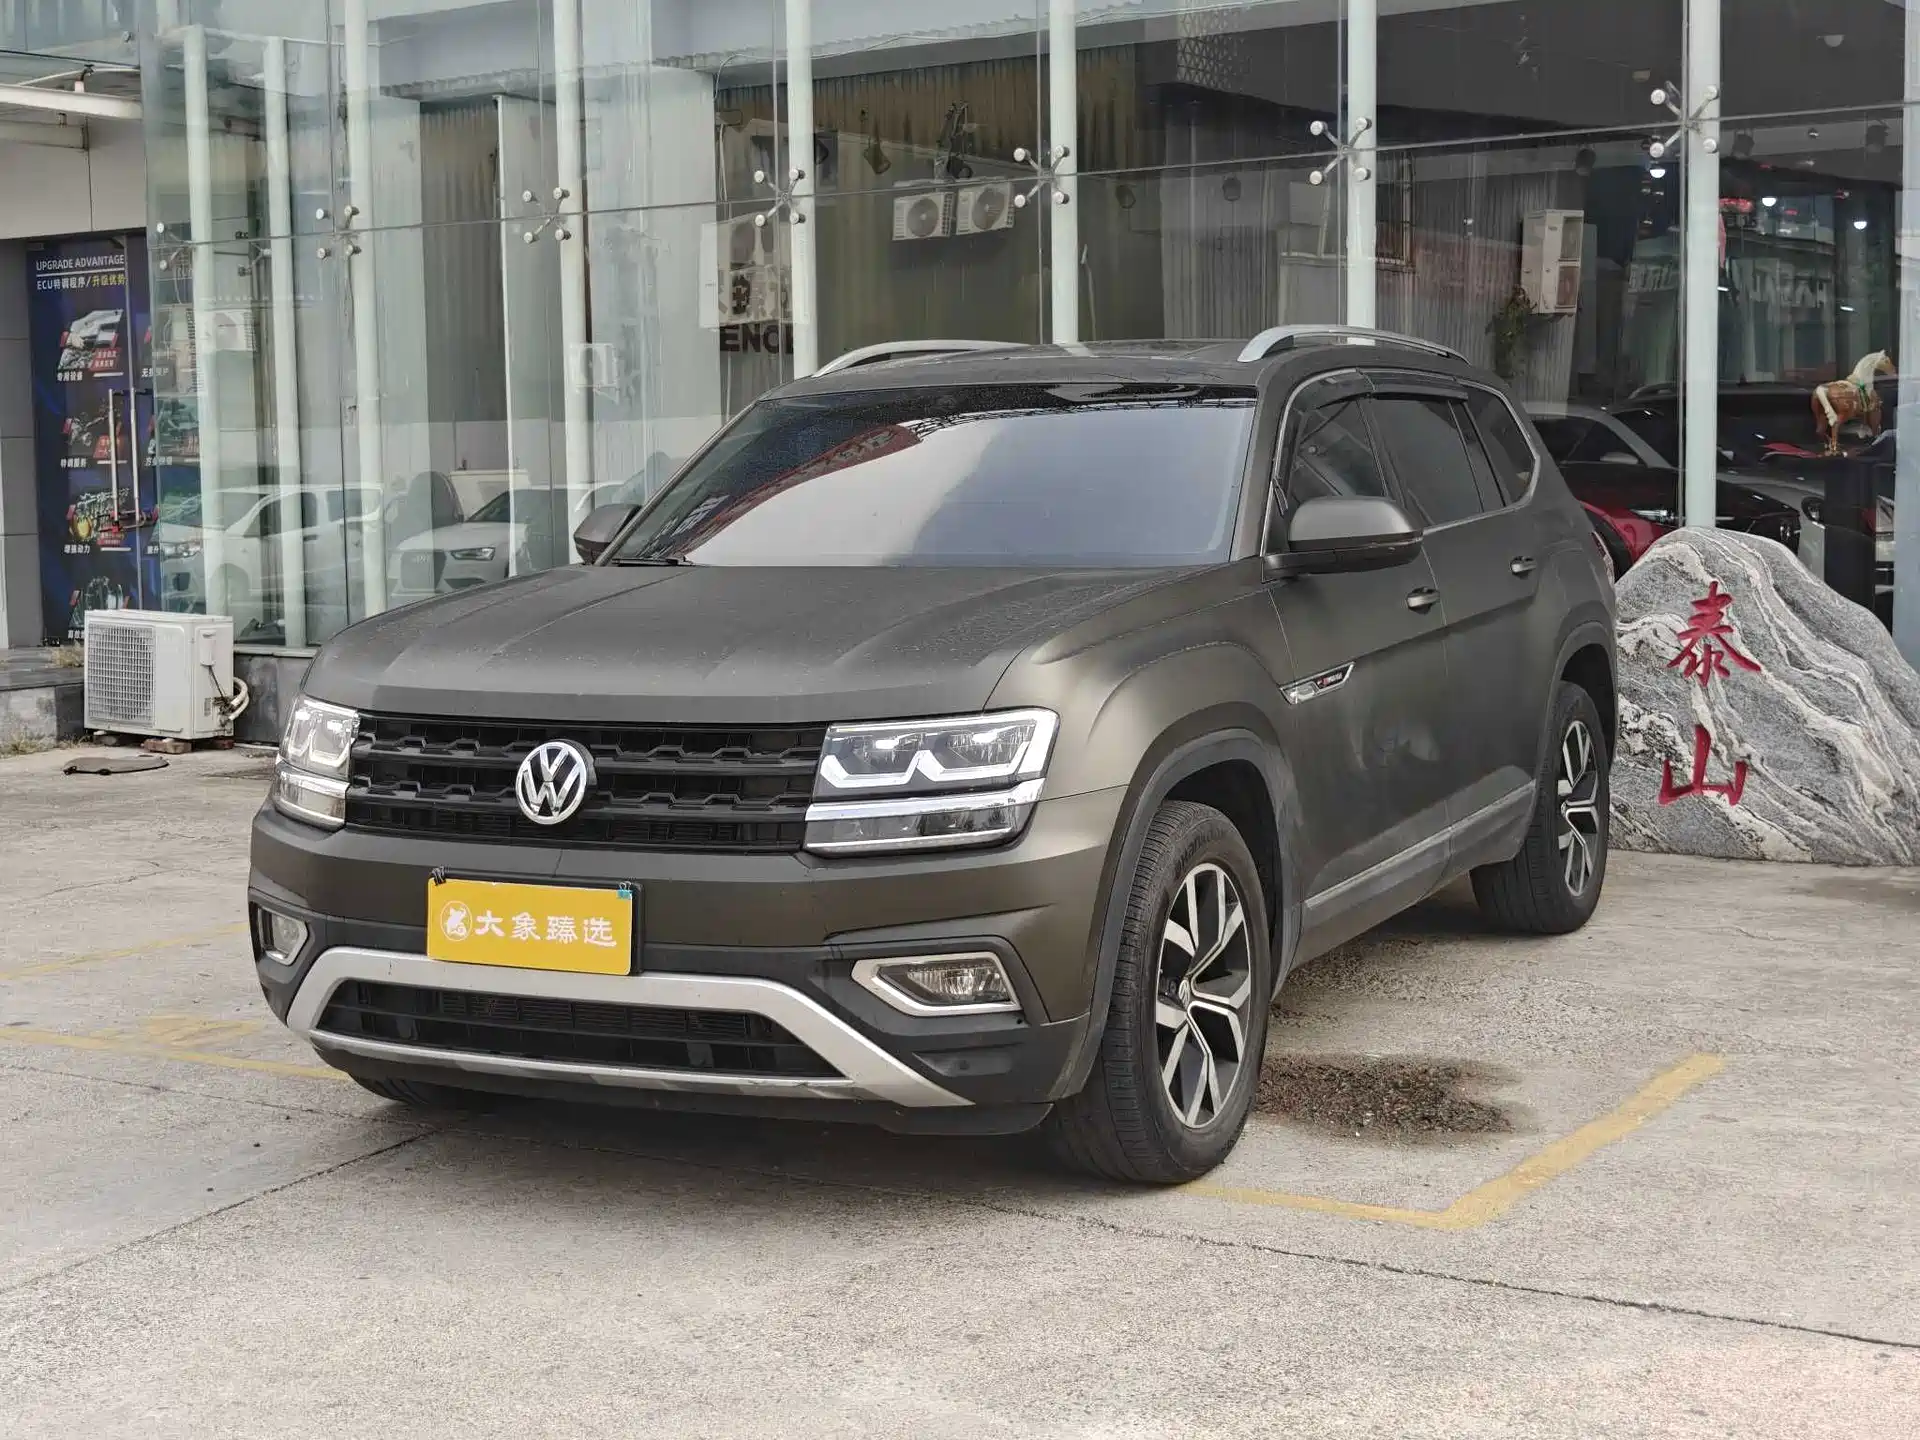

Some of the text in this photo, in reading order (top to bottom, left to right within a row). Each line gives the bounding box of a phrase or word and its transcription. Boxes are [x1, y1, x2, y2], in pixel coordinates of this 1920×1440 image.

[36, 254, 125, 271] UPGRADE ADVANTAGE
[1656, 580, 1761, 807] 泰山
[516, 742, 587, 824] VW
[475, 910, 617, 947] 大象臻选
